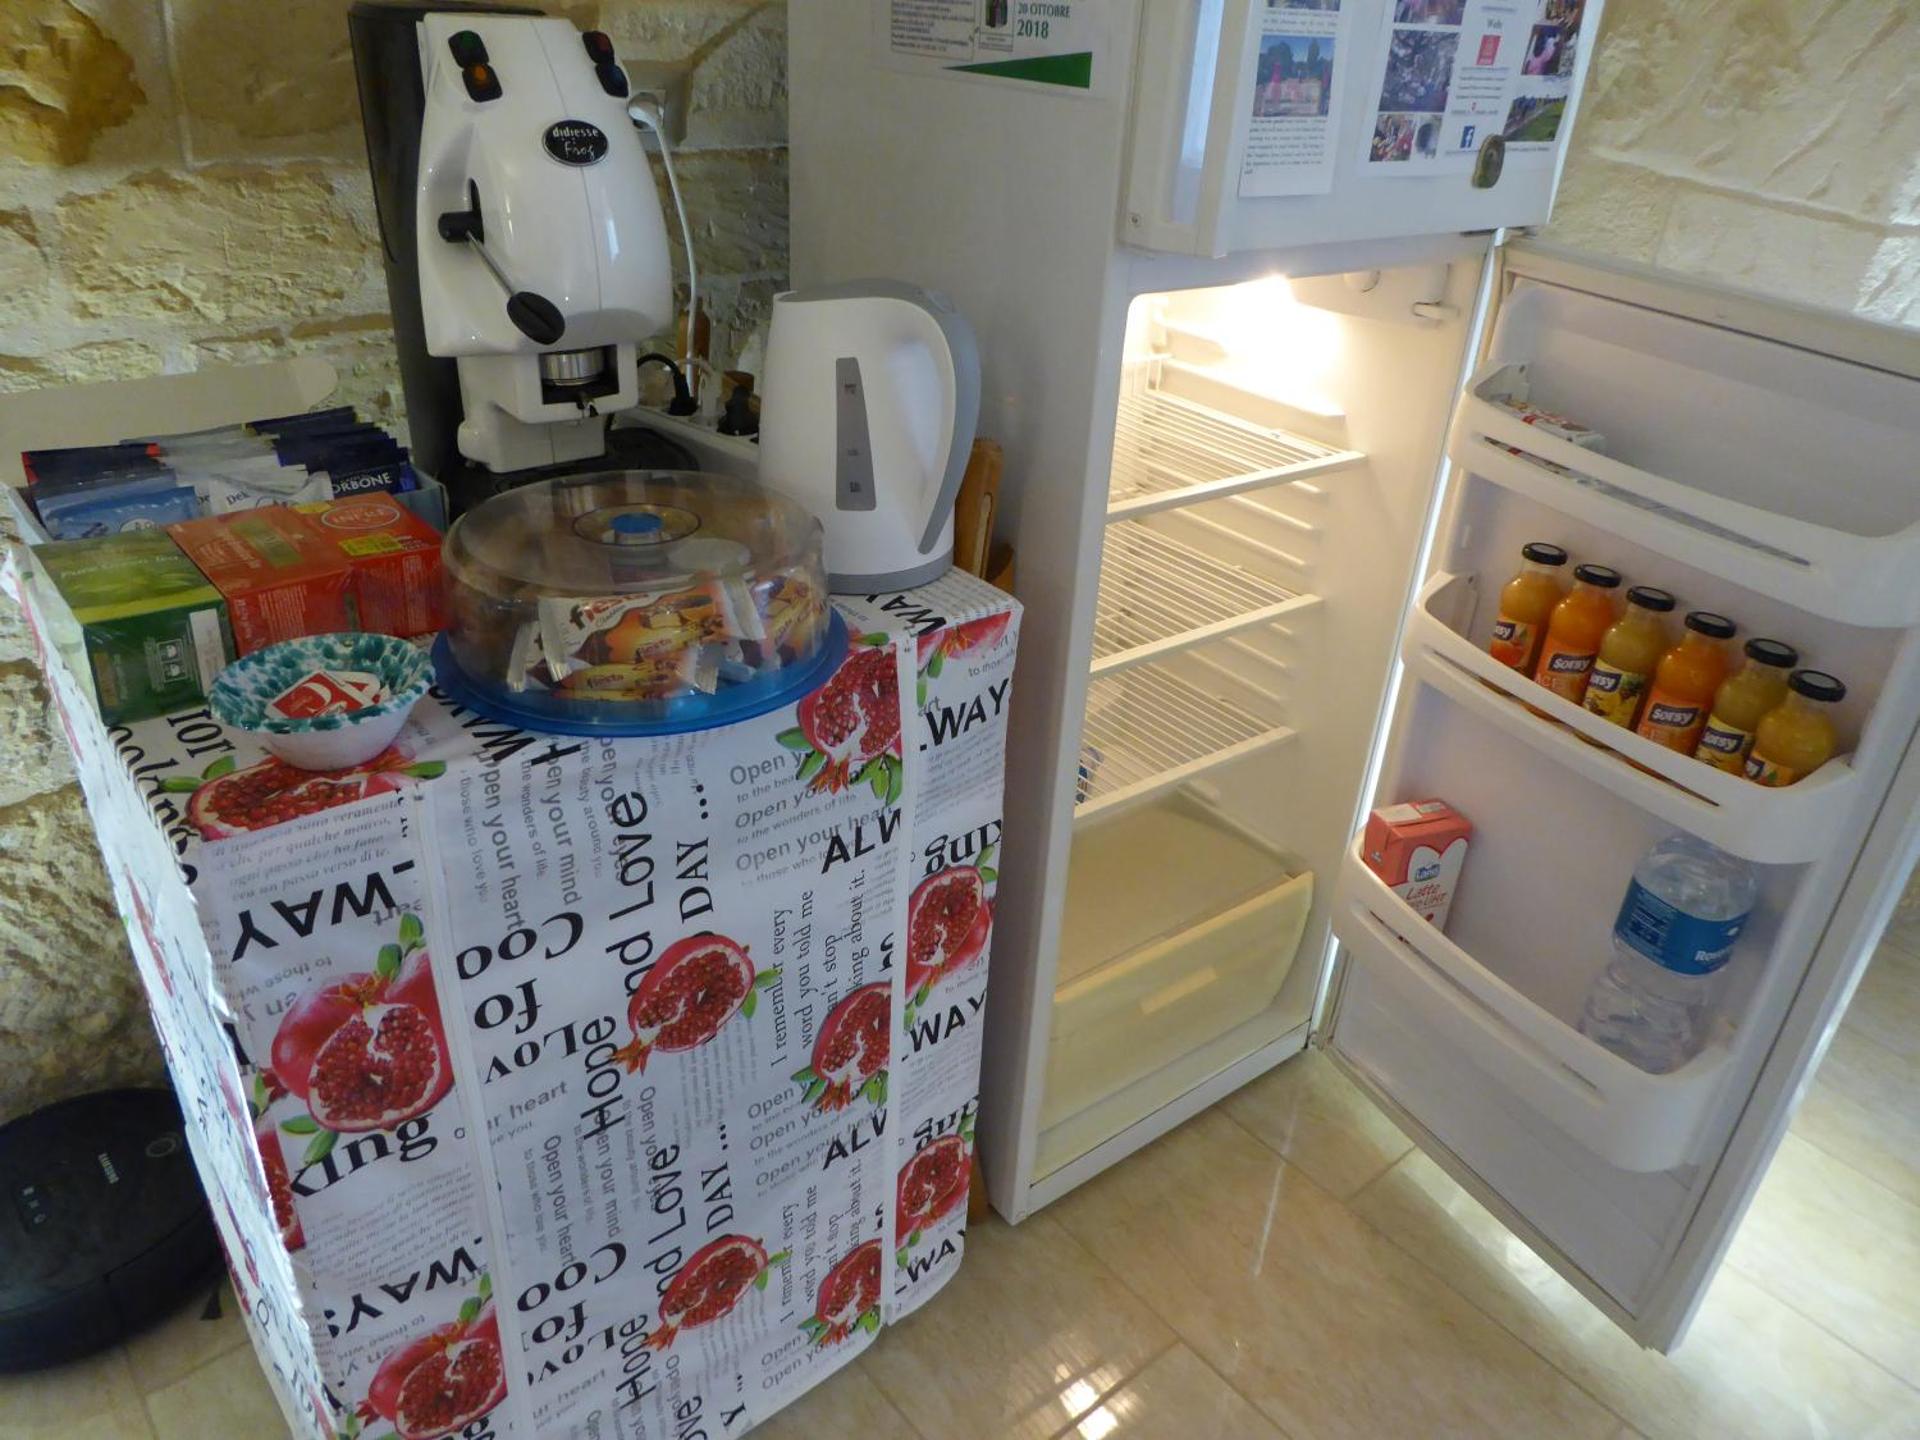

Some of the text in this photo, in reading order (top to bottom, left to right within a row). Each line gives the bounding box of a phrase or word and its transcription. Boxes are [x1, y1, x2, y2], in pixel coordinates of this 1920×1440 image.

[1017, 18, 1049, 40] 2018
[1029, 3, 1071, 18] OTTOBRE
[919, 677, 1010, 751] WAY
[729, 754, 786, 786] Open
[735, 798, 787, 829] Open
[540, 792, 573, 846] your
[559, 854, 583, 906] mind
[735, 842, 790, 872] Open
[796, 821, 842, 853] your
[483, 813, 516, 870] your
[501, 874, 526, 931] heart
[605, 791, 656, 998] nd Love
[675, 836, 715, 925] DAY
[231, 860, 415, 963] WAY
[773, 908, 793, 955] every
[844, 893, 864, 943] about
[793, 889, 819, 1049] word you told me
[823, 934, 843, 973] stop
[901, 988, 988, 1062] WAY
[509, 1080, 568, 1120] heart
[636, 1085, 657, 1130] Open
[747, 1087, 795, 1120] Open
[750, 1119, 796, 1151] Open
[541, 1134, 563, 1184] Open
[595, 1155, 616, 1195] your
[755, 1156, 800, 1187] Open
[547, 1182, 569, 1222] your
[648, 1144, 687, 1245] Love
[700, 1160, 735, 1234] DAY
[806, 1184, 818, 1209] me
[605, 1197, 622, 1239] mind
[346, 1236, 483, 1334] WAY
[759, 1332, 802, 1367] Open
[760, 1357, 803, 1391] Open
